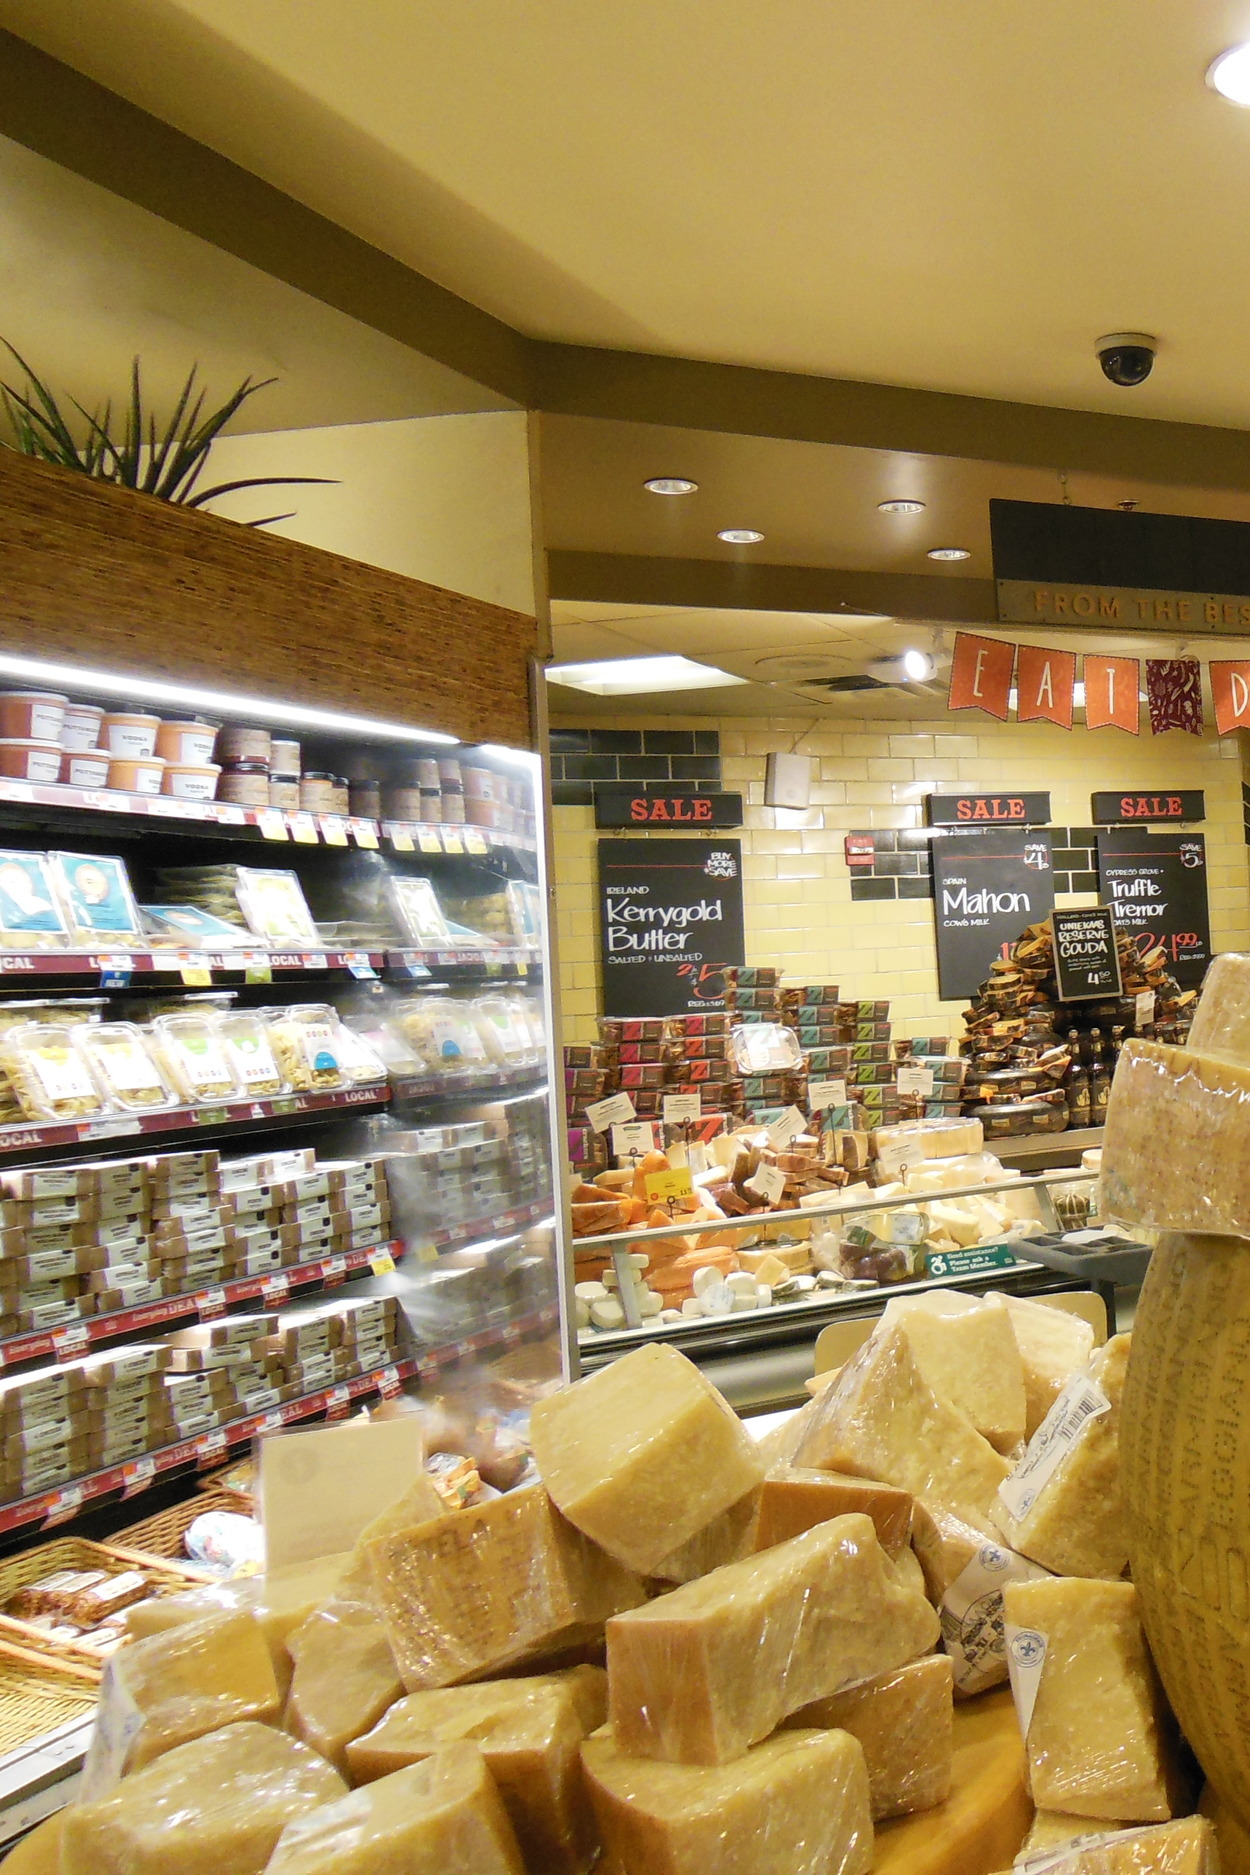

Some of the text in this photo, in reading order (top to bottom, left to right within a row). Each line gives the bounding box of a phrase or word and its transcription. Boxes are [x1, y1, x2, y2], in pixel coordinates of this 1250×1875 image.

[1032, 590, 1121, 618] FROM
[1137, 599, 1191, 622] THE
[973, 648, 1117, 716] EAT
[630, 798, 713, 821] SALE
[957, 798, 1025, 820] SALE
[1120, 797, 1183, 817] SALE
[710, 852, 732, 860] BUY
[1024, 844, 1048, 852] SAVE
[1179, 844, 1204, 852] SAVE
[707, 860, 737, 869] MORE
[606, 886, 649, 895] IRELAND
[1107, 878, 1163, 898] Truffle
[942, 886, 1031, 916] Mahon
[1107, 899, 1169, 918] Tremor
[606, 896, 723, 928] Kerrygold
[971, 918, 990, 926] MILK
[1132, 918, 1149, 926] MILK
[608, 926, 694, 952] Butter
[1058, 929, 1110, 943] RESERVE
[1060, 940, 1109, 958] GOUDA
[608, 953, 703, 964] SALTED UNSALTED
[345, 1090, 378, 1102] LOCAL
[0, 1130, 43, 1148] OCAL
[947, 1251, 963, 1260] Need
[951, 1265, 970, 1273] Team
